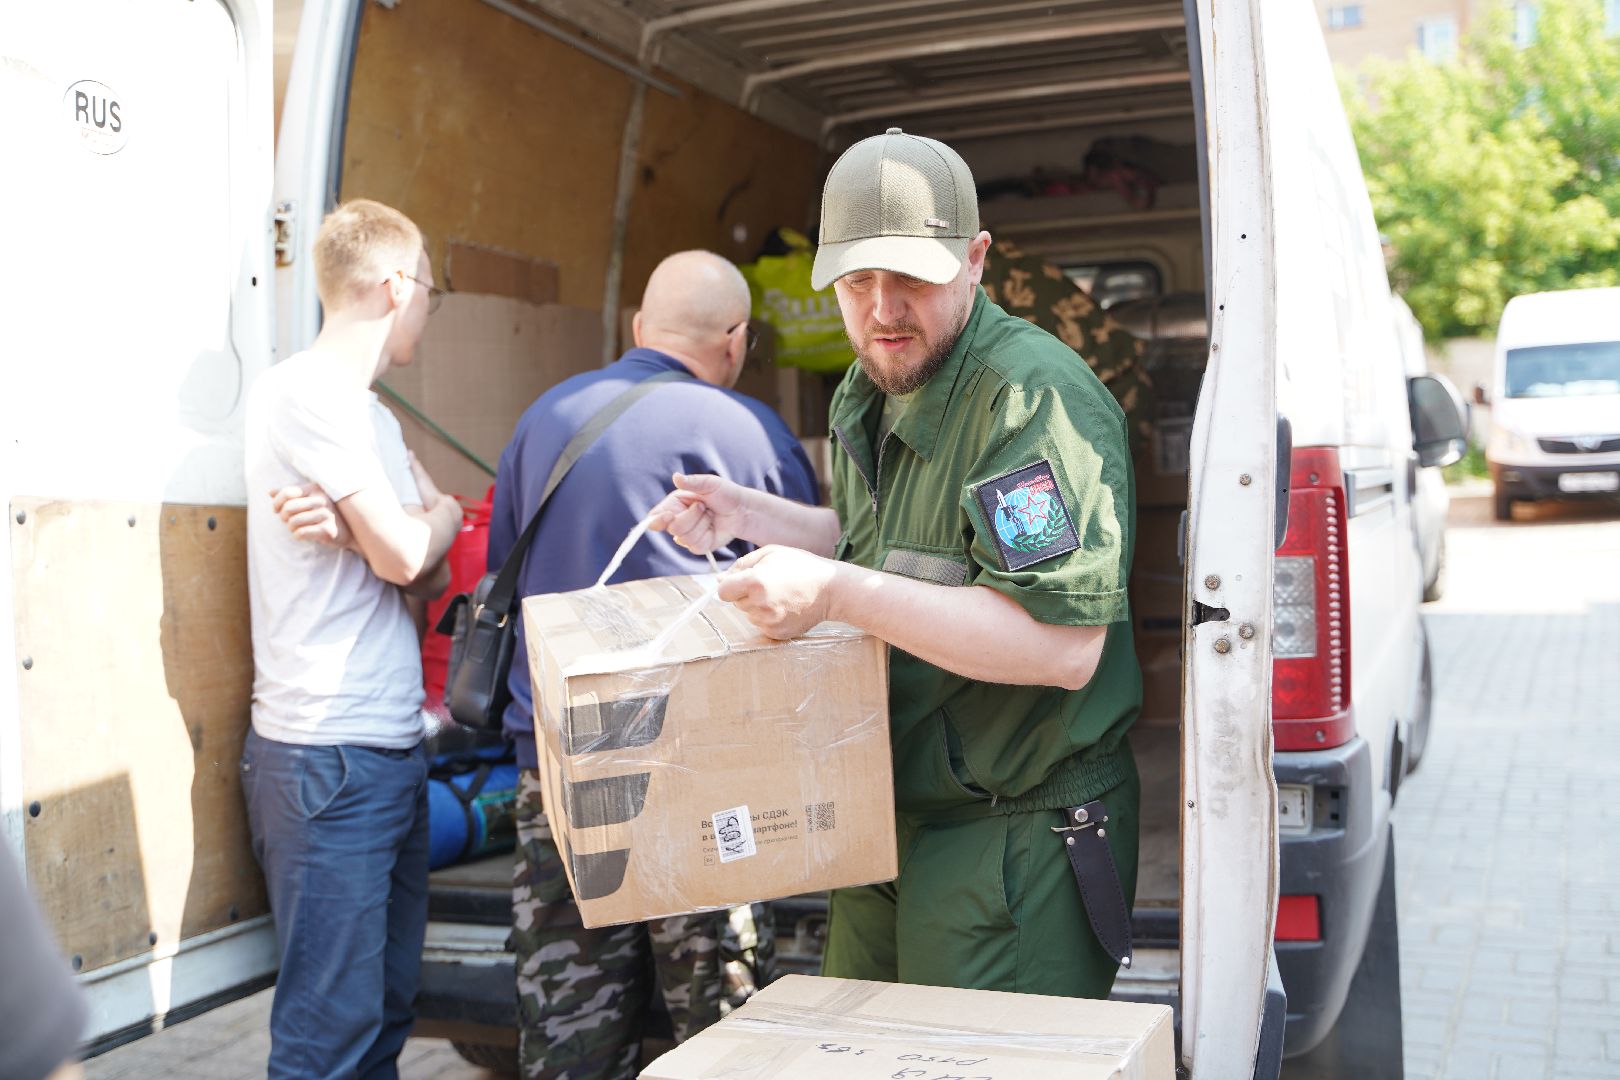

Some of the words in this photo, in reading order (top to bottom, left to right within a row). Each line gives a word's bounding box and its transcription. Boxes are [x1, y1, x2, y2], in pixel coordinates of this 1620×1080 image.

[75, 90, 122, 133] RUS
[701, 820, 713, 829] Вс
[762, 809, 789, 820] СДЭК
